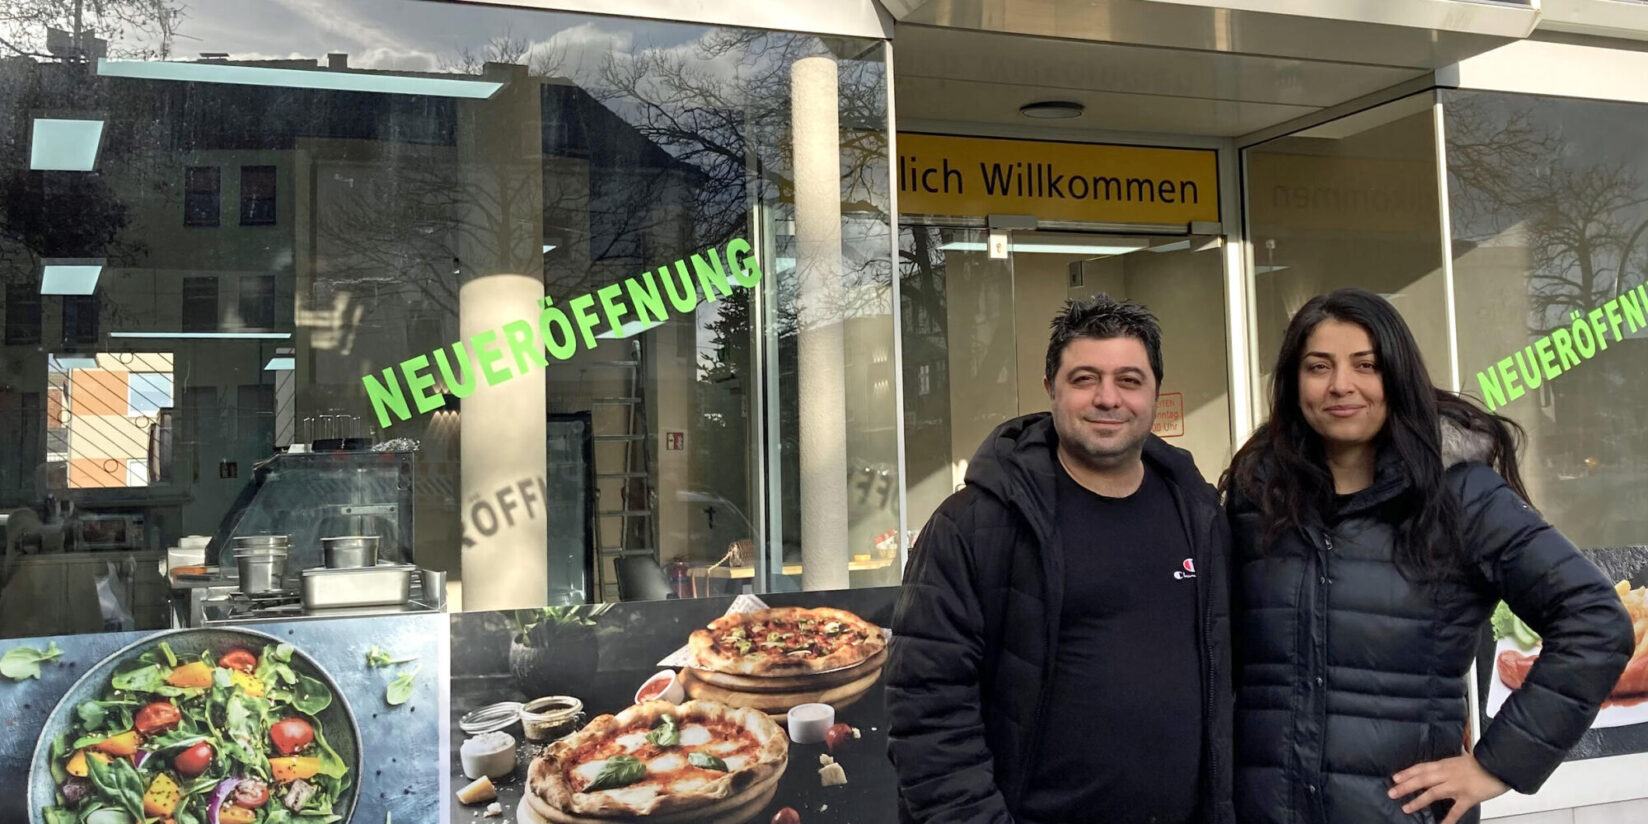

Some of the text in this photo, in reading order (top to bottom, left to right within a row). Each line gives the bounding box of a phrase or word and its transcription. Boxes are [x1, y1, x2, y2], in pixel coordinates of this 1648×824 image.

[900, 155, 1199, 204] lich Willkommen
[362, 238, 763, 429] NEUERÖFFNUNG
